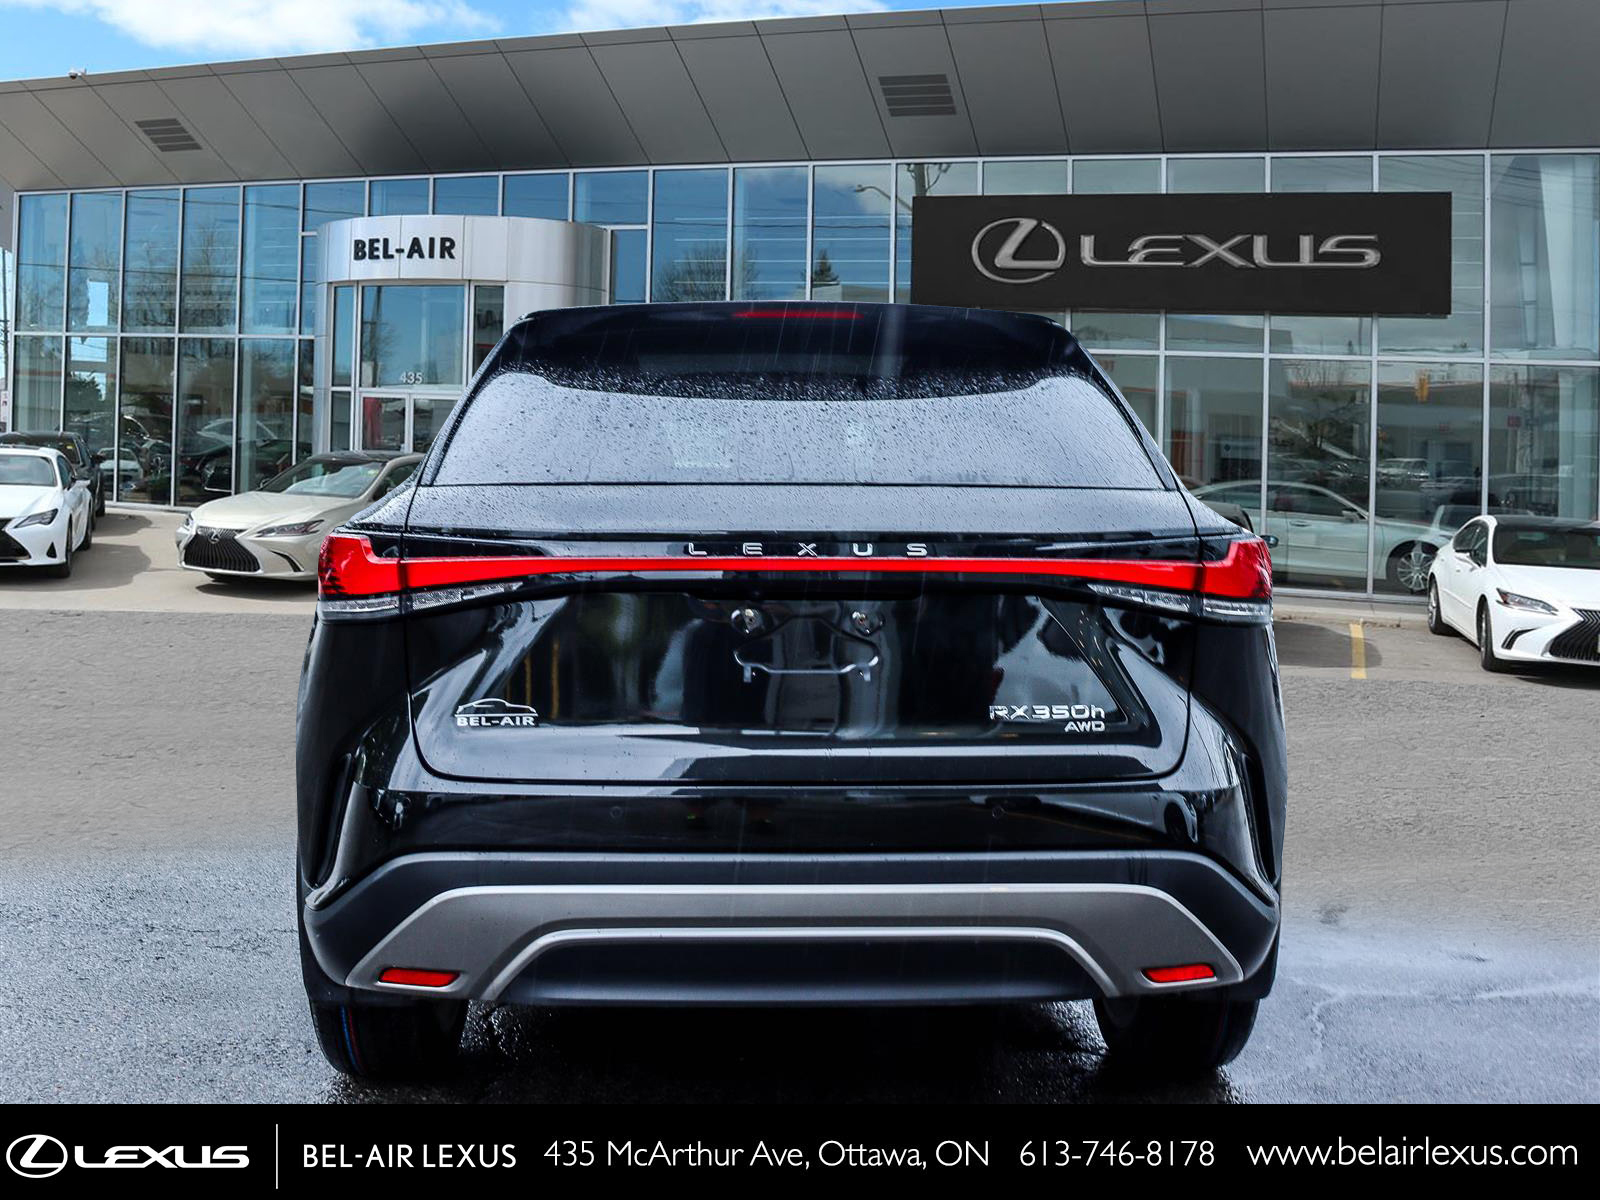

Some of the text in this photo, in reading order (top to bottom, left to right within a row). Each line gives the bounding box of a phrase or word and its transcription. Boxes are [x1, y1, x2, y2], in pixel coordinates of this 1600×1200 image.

[353, 237, 456, 261] BEL-AIR
[1080, 234, 1381, 268] LEXUS
[400, 371, 423, 385] 435
[687, 542, 929, 557] LEXUS
[455, 716, 536, 727] BEL-AIR
[1064, 720, 1106, 733] AWD
